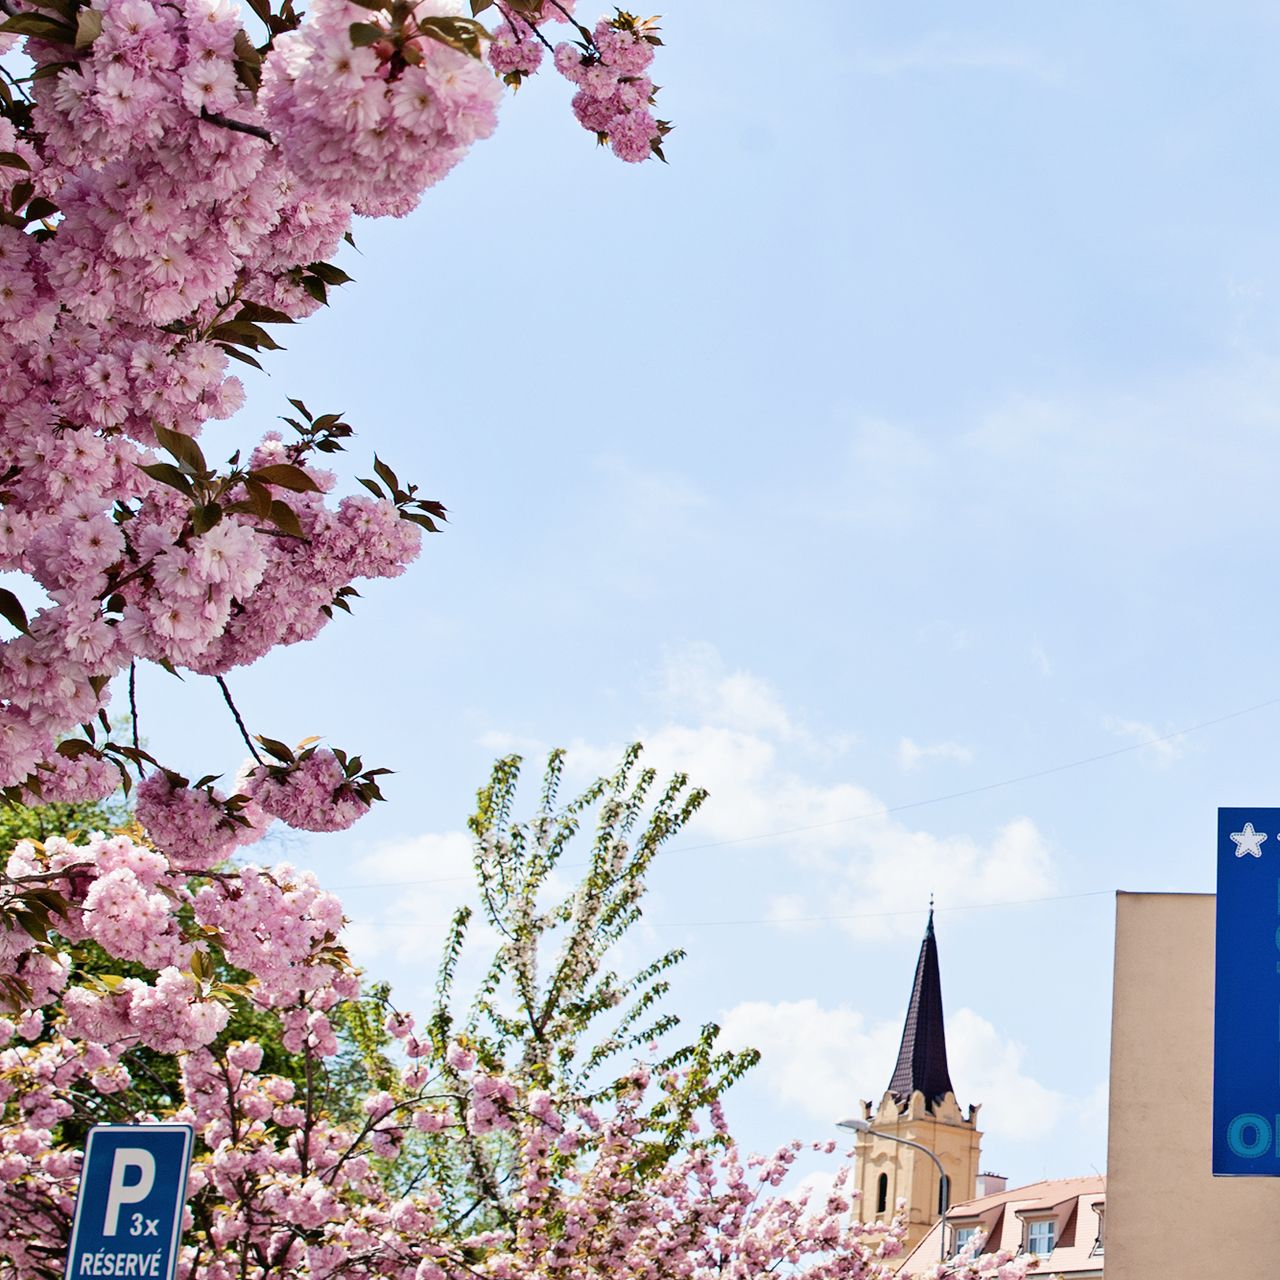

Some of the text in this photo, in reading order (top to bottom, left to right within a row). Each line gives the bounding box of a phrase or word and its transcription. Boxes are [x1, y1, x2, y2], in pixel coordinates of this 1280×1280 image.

[103, 1147, 161, 1237] P 3x
[79, 1247, 163, 1277] RÉSERVÉ
